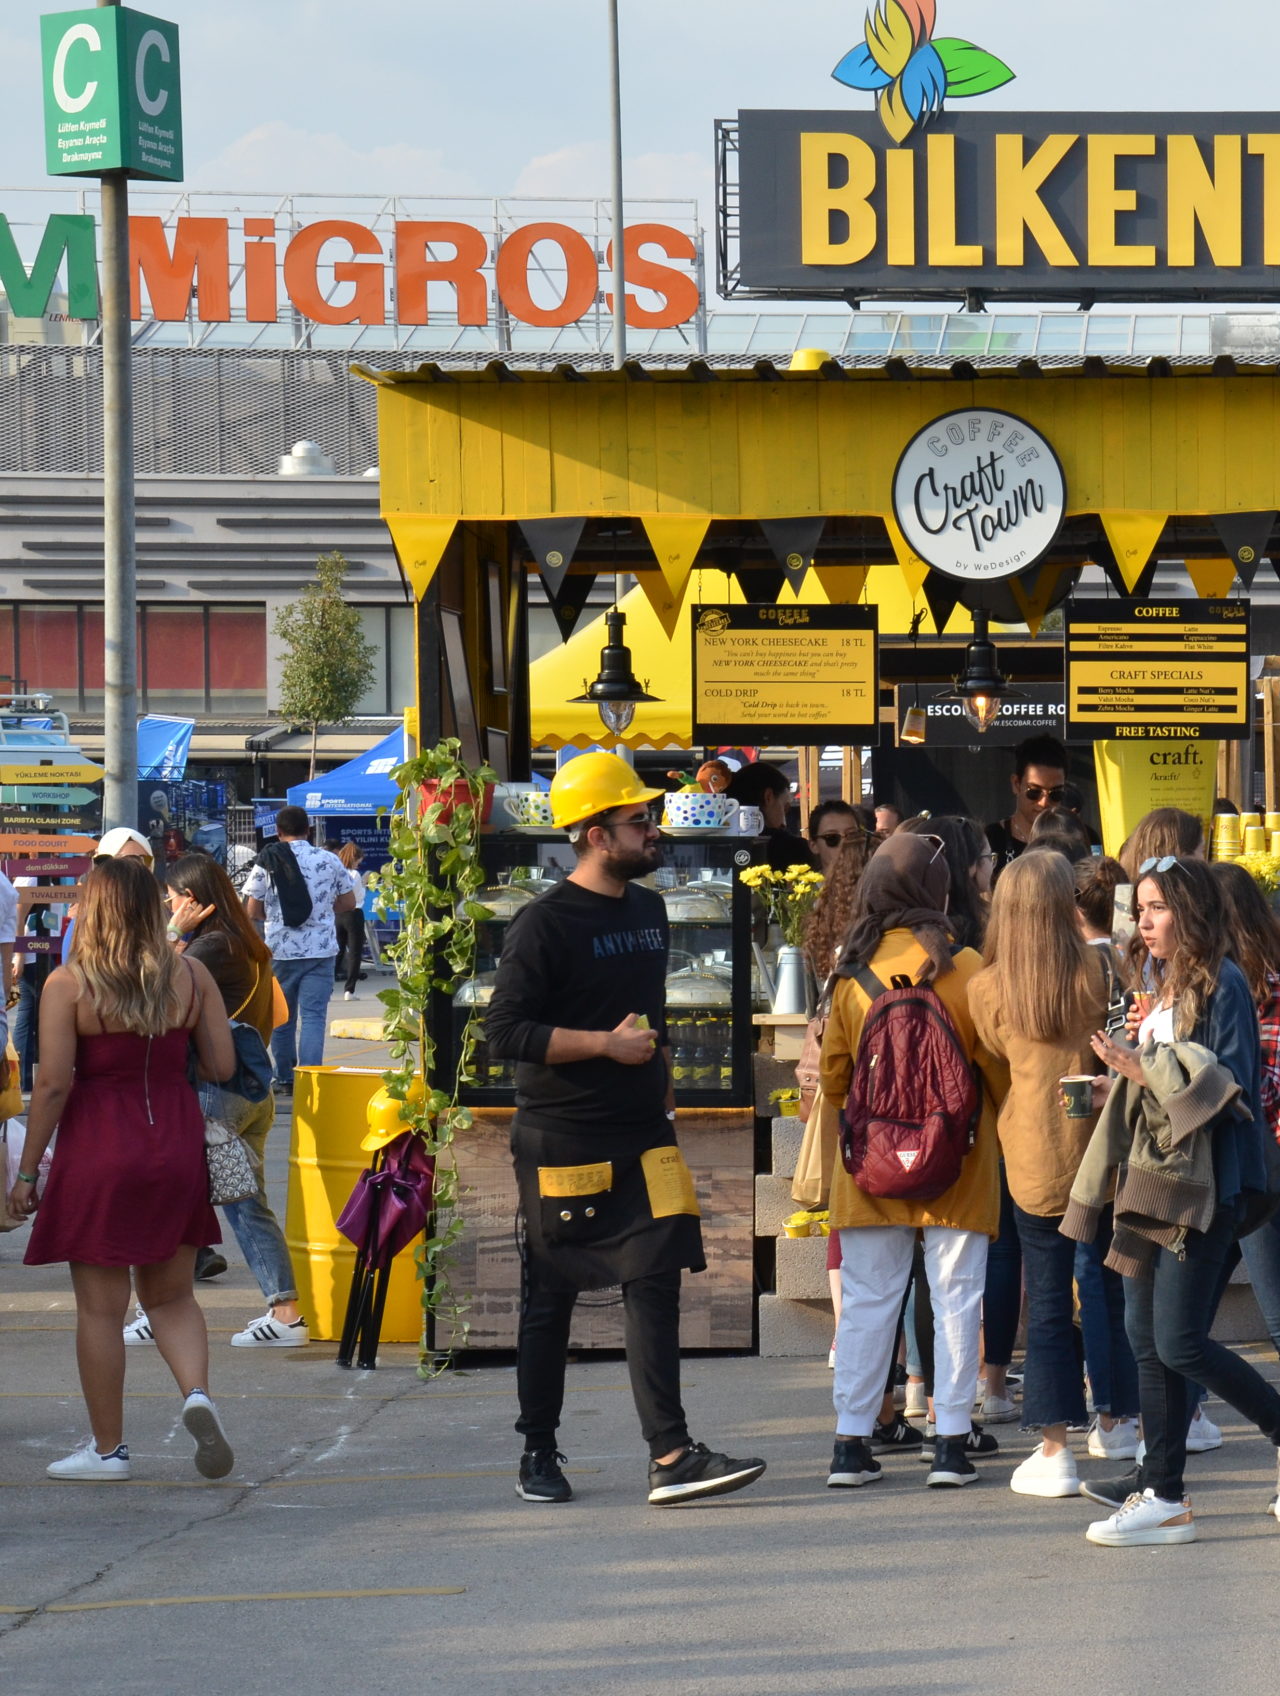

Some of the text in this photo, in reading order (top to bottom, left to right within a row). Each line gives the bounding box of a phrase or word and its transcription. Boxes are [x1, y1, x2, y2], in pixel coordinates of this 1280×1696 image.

[53, 23, 102, 114] C
[135, 30, 171, 116] C
[926, 418, 1040, 468] COFFEE
[914, 450, 1004, 535] Craft
[952, 478, 1044, 552] Town
[955, 549, 1027, 572] by WeDesign
[758, 608, 809, 619] COFFEE
[1134, 607, 1180, 617] COFFEE
[704, 638, 866, 647] NEW YORK CHEESECAKE 18 TL
[1110, 670, 1203, 680] CRAFT SPECIALS
[704, 689, 758, 697] COLD DRIP
[841, 689, 866, 697] 18 TL
[761, 701, 778, 710] Drip
[1115, 726, 1200, 737] FREE TASTING
[1149, 743, 1204, 766] craft.
[15, 770, 49, 779] YÜKLEME
[27, 942, 50, 950] ÇIKIŞ
